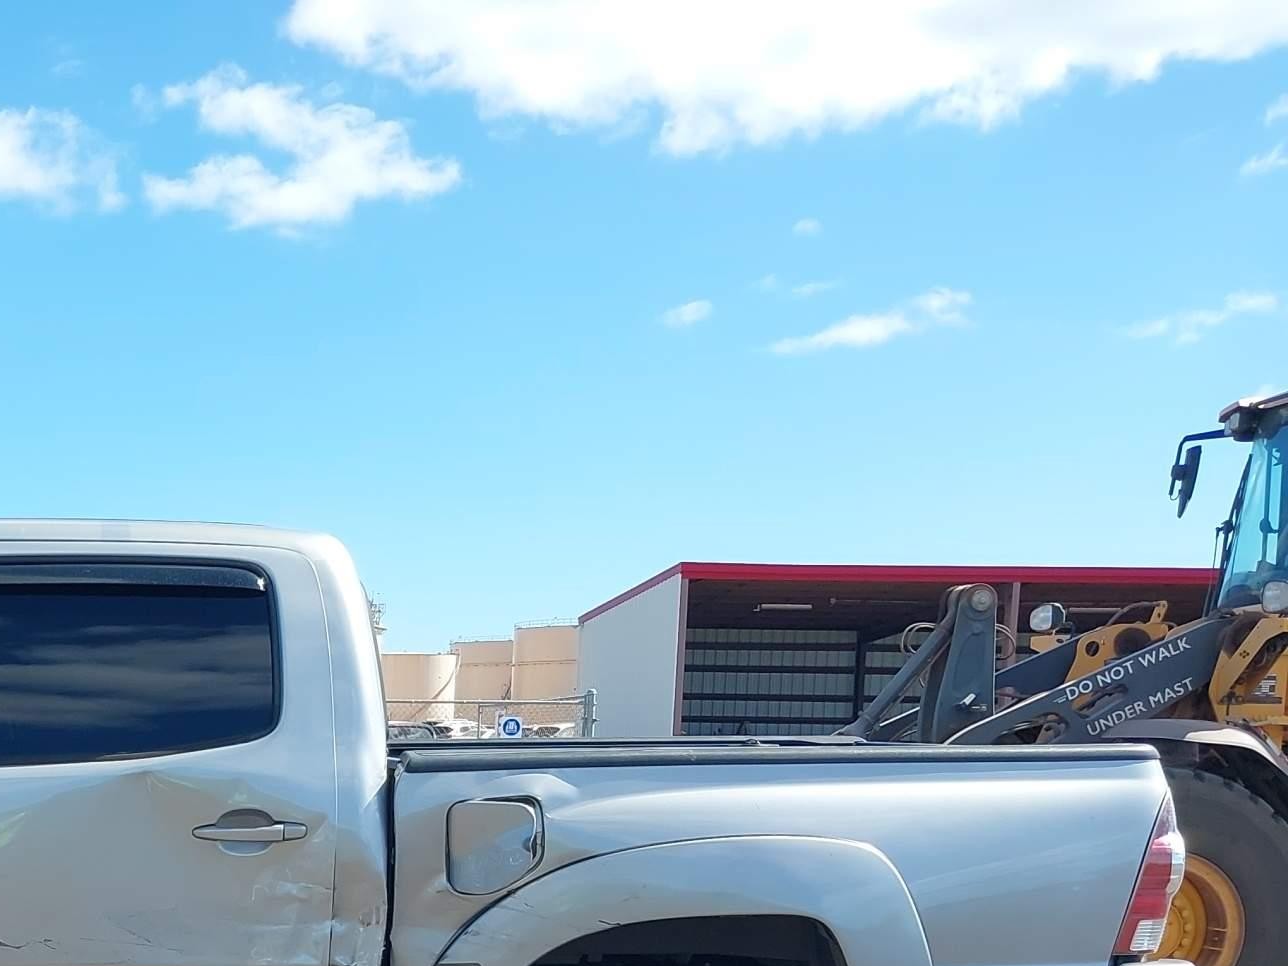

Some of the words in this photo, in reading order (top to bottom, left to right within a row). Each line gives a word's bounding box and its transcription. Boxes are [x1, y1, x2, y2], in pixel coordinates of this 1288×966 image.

[1066, 680, 1093, 701] DO
[1096, 660, 1134, 687] NOT
[1138, 637, 1192, 668] WALK
[1086, 701, 1147, 736] UNDER
[1148, 677, 1194, 708] MAST
